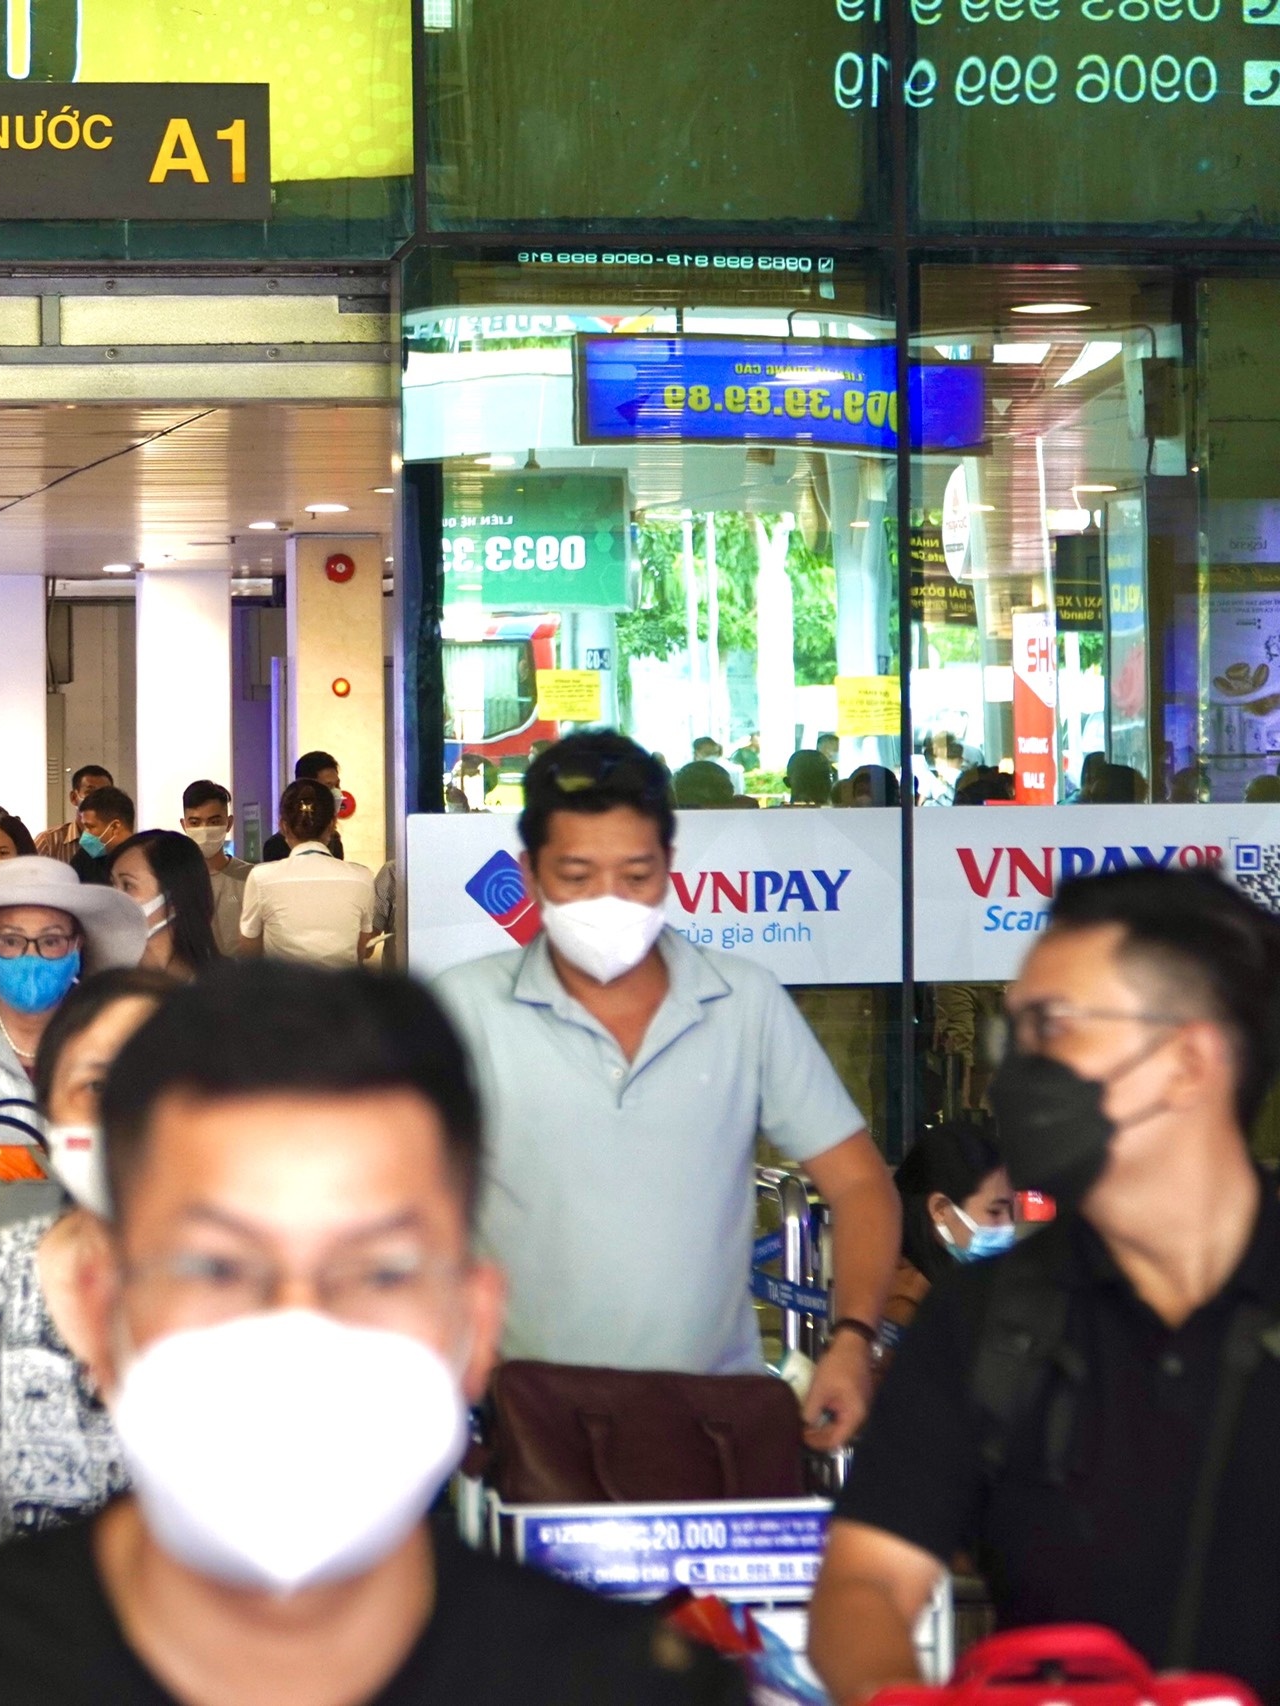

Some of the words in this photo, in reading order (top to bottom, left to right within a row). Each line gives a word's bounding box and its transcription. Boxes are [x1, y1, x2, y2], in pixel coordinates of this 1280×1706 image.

[148, 117, 246, 184] A1
[669, 869, 852, 914] VNPAY
[722, 925, 754, 949] gia
[762, 921, 812, 945] đình
